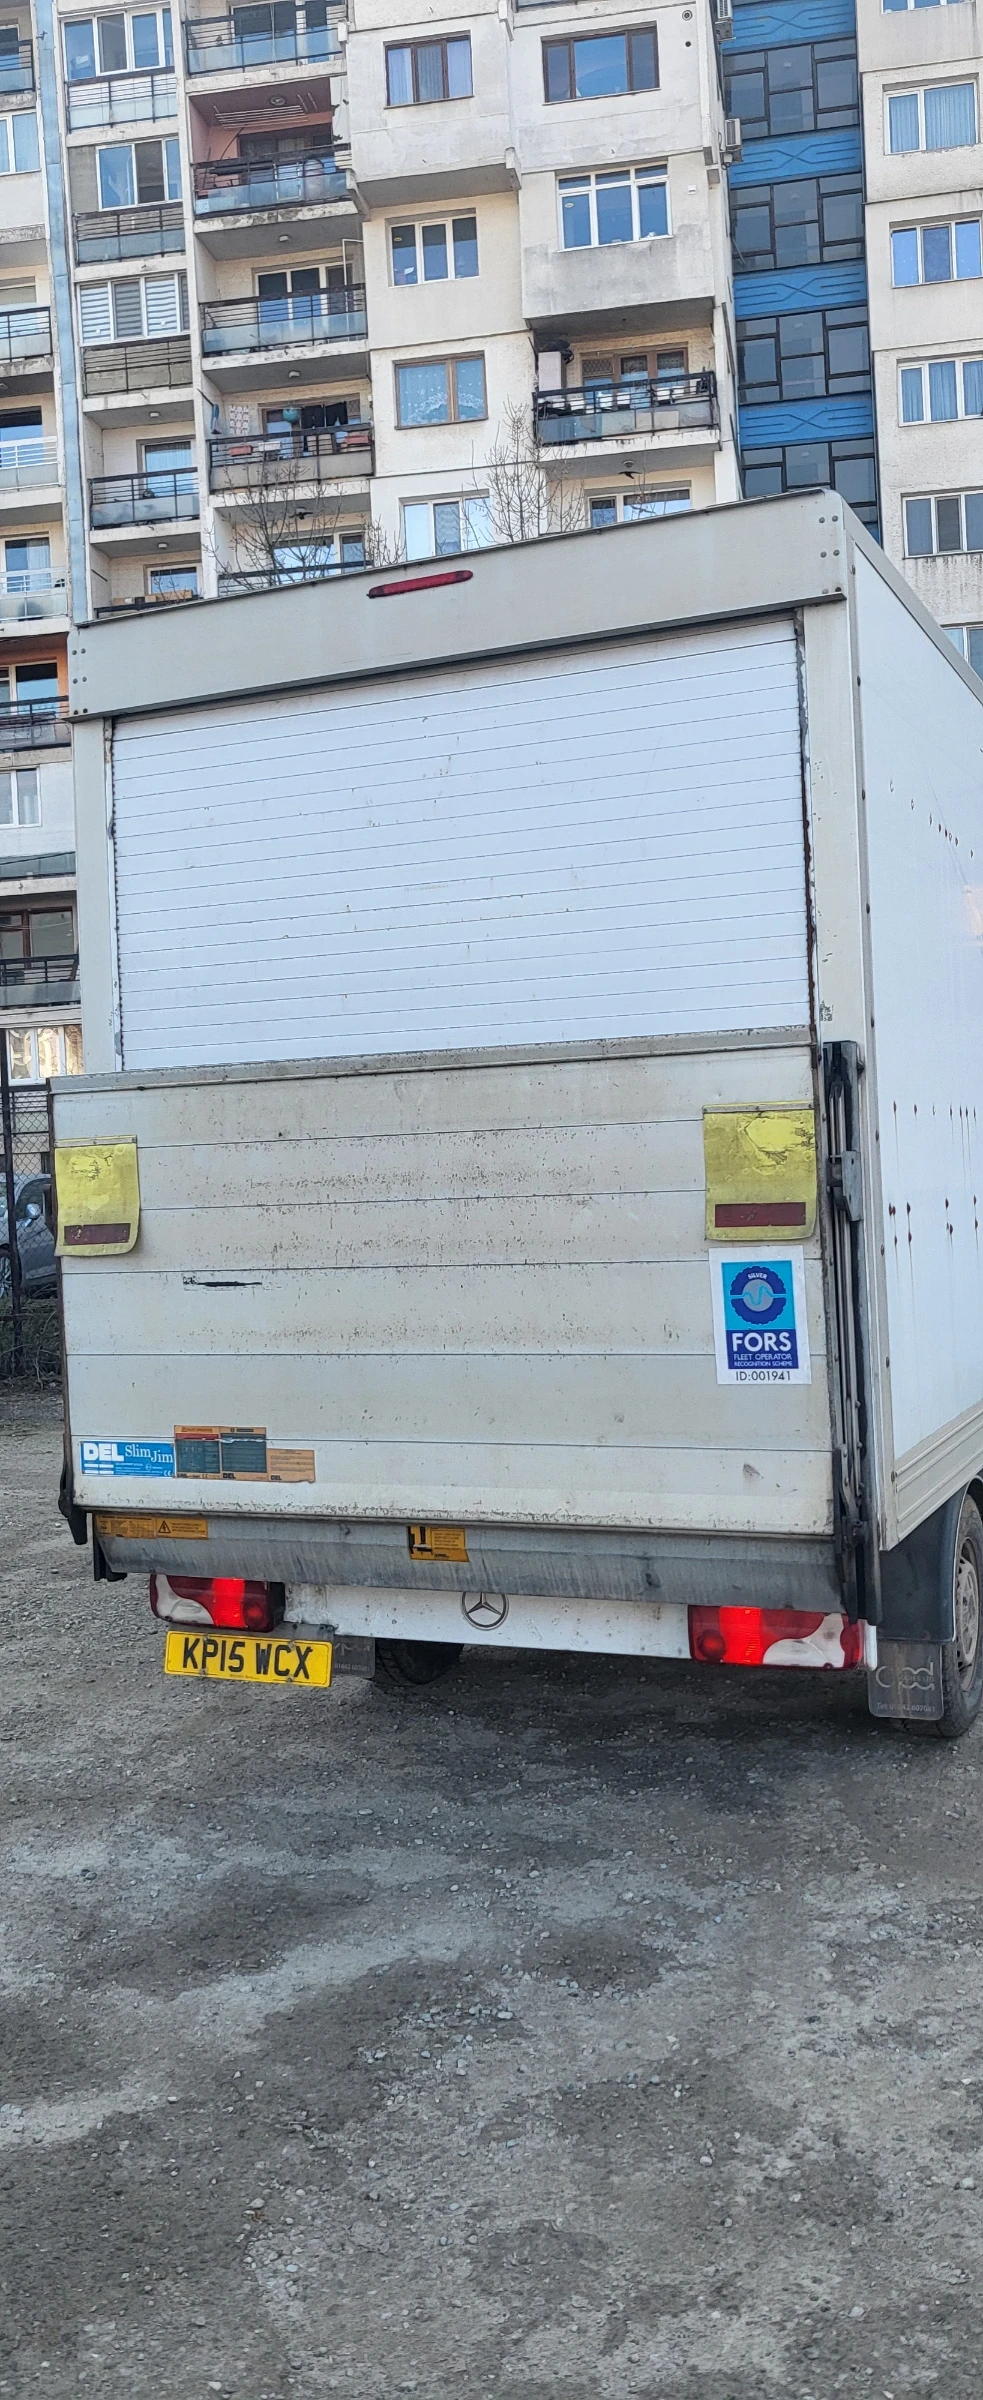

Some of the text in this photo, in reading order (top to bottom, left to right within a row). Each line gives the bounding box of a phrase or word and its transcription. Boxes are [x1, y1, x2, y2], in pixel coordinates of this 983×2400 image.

[747, 1272, 768, 1280] SILVER
[732, 1332, 792, 1352] FORS
[736, 1371, 791, 1381] ID:001941
[83, 1443, 125, 1462] DEL
[125, 1443, 152, 1458] Slim
[150, 1449, 174, 1463] Jim
[183, 1637, 245, 1673] KP15
[255, 1643, 313, 1680] WCX
